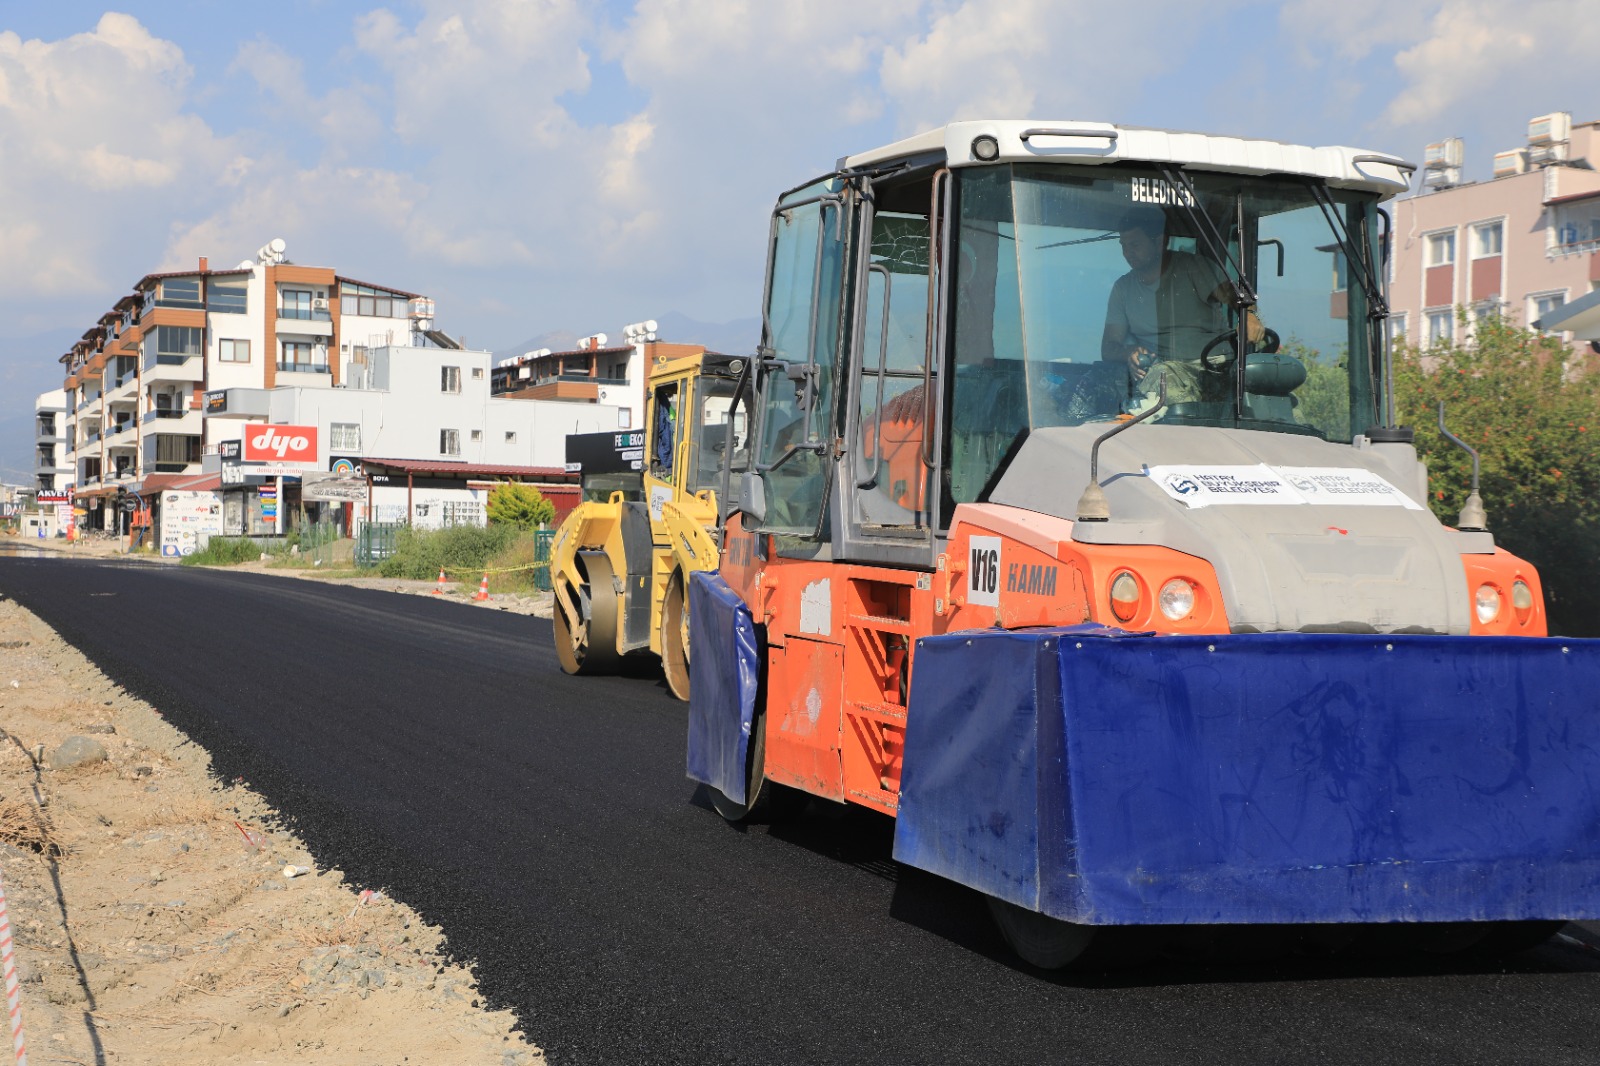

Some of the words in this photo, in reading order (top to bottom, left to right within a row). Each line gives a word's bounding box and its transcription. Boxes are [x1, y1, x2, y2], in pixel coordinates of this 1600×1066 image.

[251, 427, 309, 458] dyo
[971, 548, 998, 594] V16
[1007, 563, 1057, 597] HAMM
